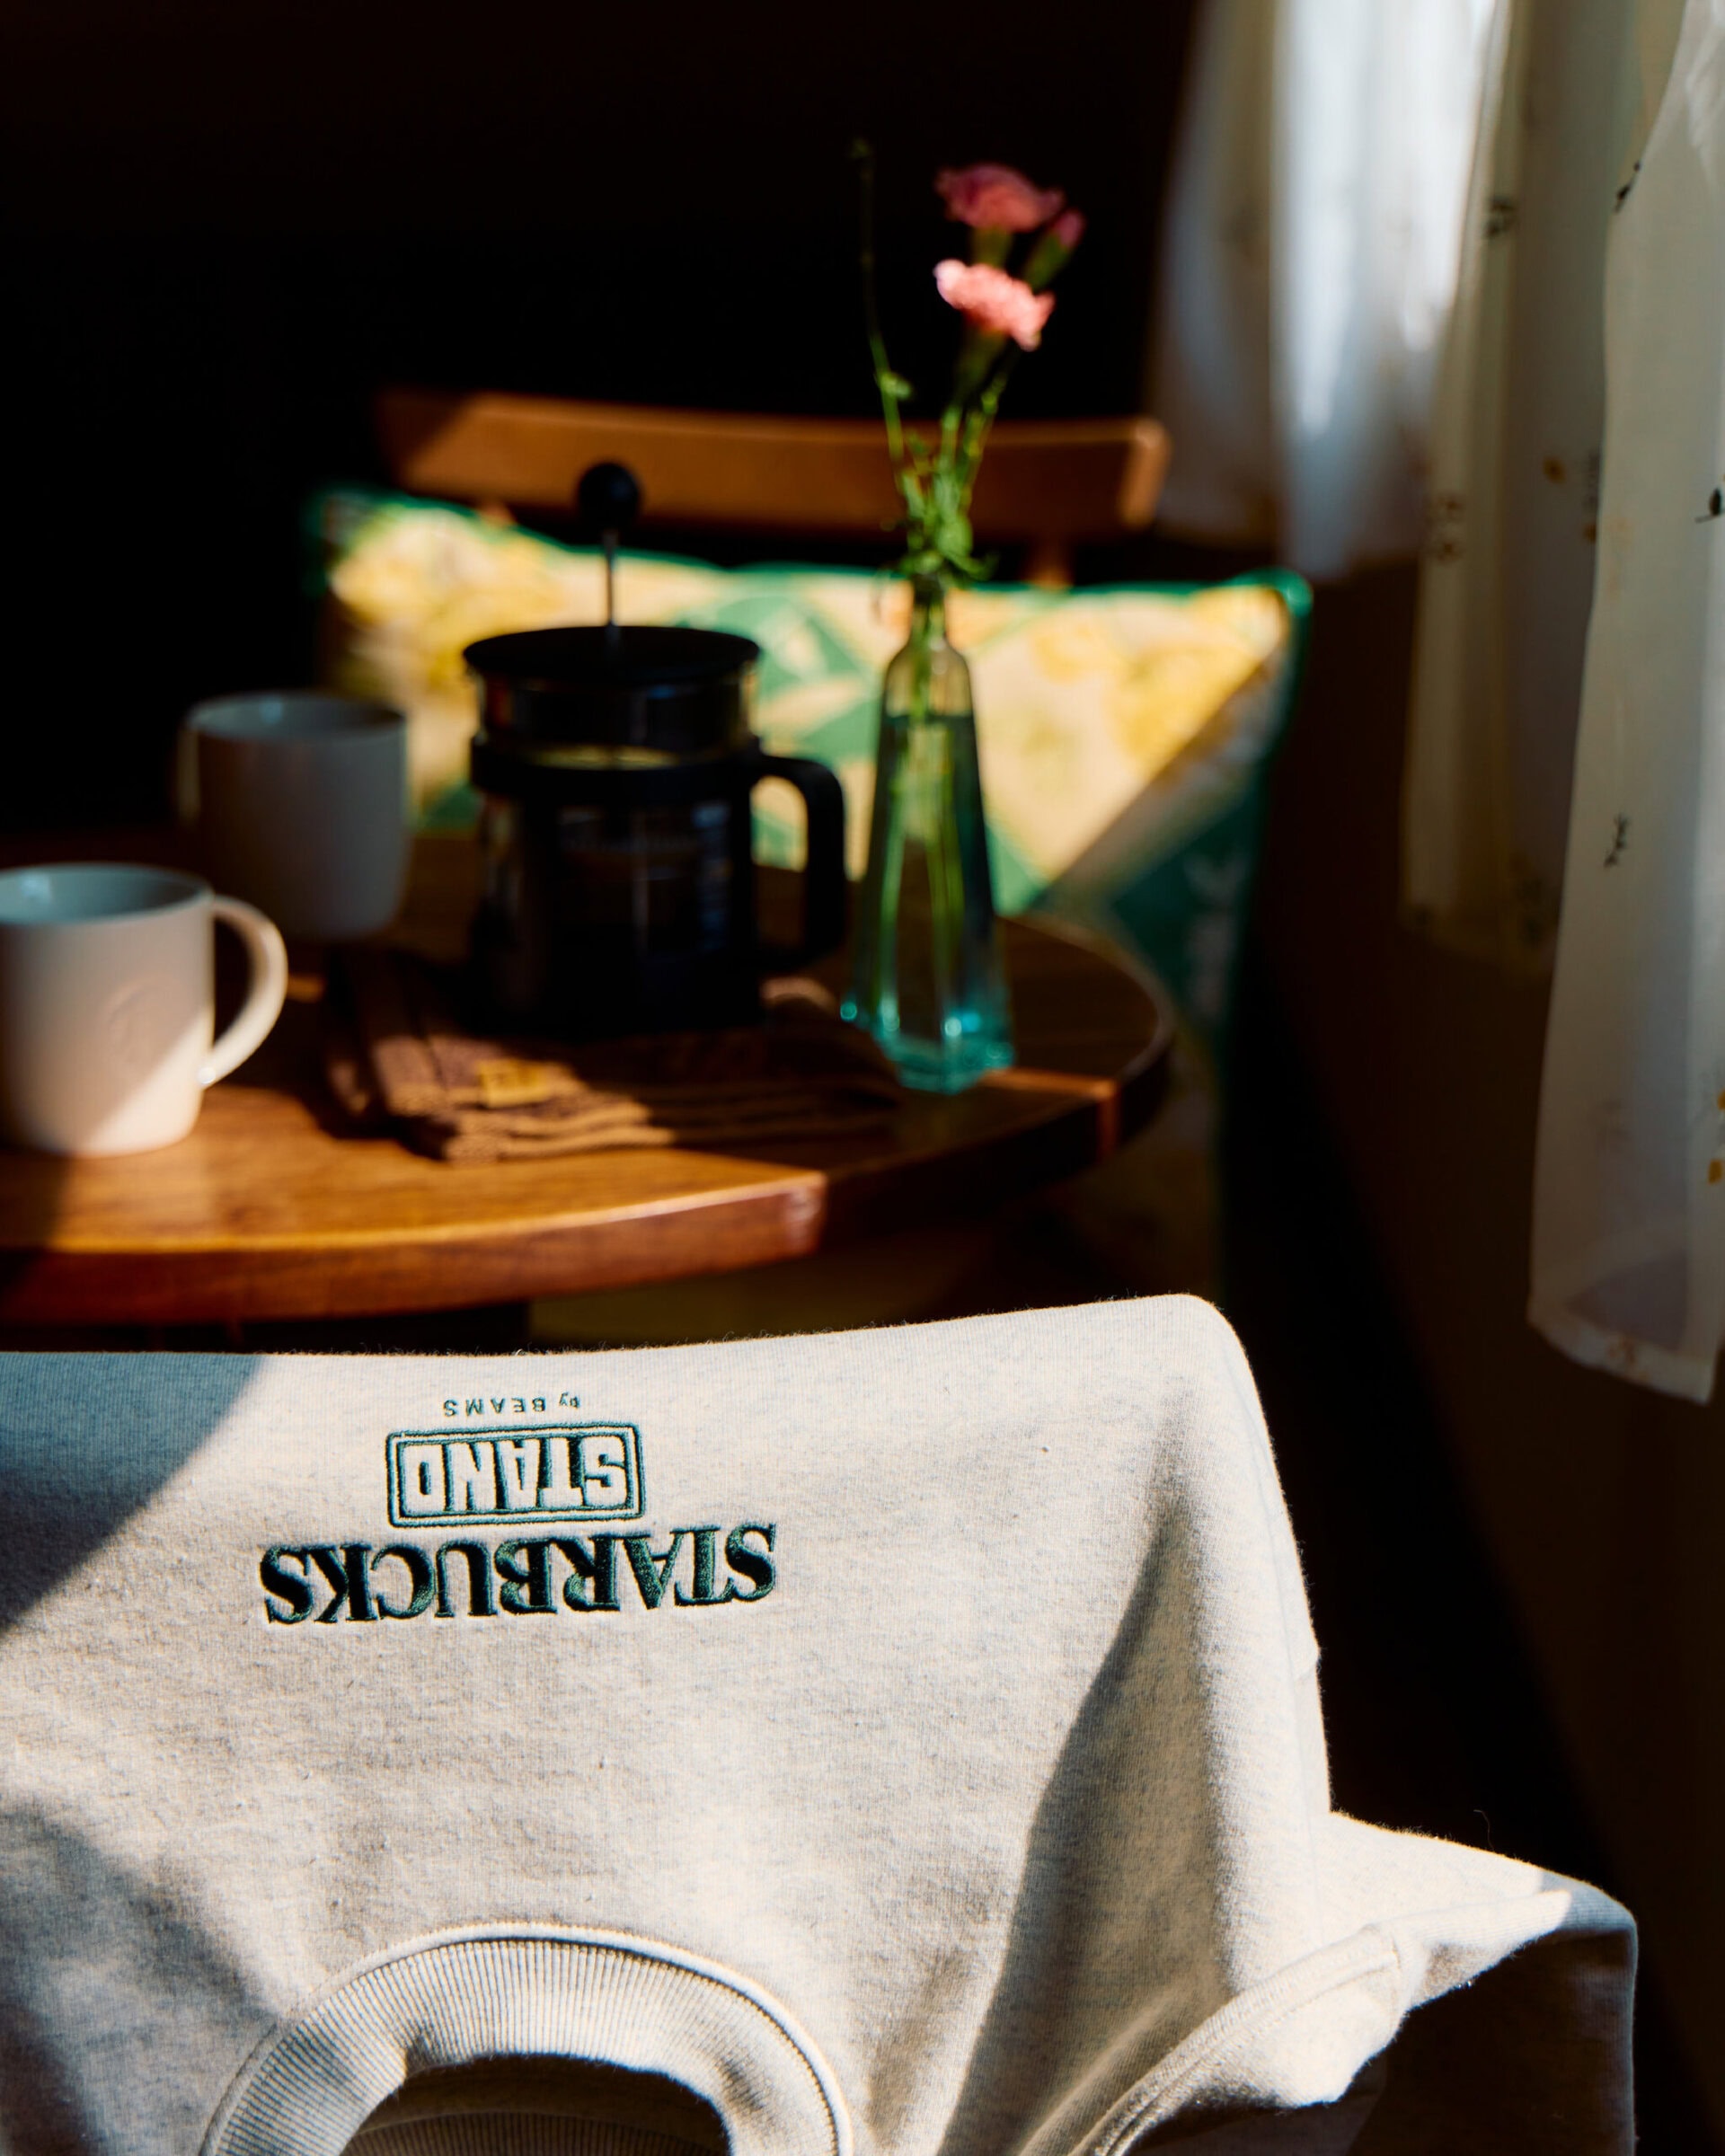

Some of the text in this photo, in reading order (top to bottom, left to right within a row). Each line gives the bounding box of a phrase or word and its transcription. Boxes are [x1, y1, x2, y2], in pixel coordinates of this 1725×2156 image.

[443, 1392, 580, 1417] by BEAMS
[402, 1435, 628, 1515] STAND
[259, 1521, 776, 1625] STARBUCKS
